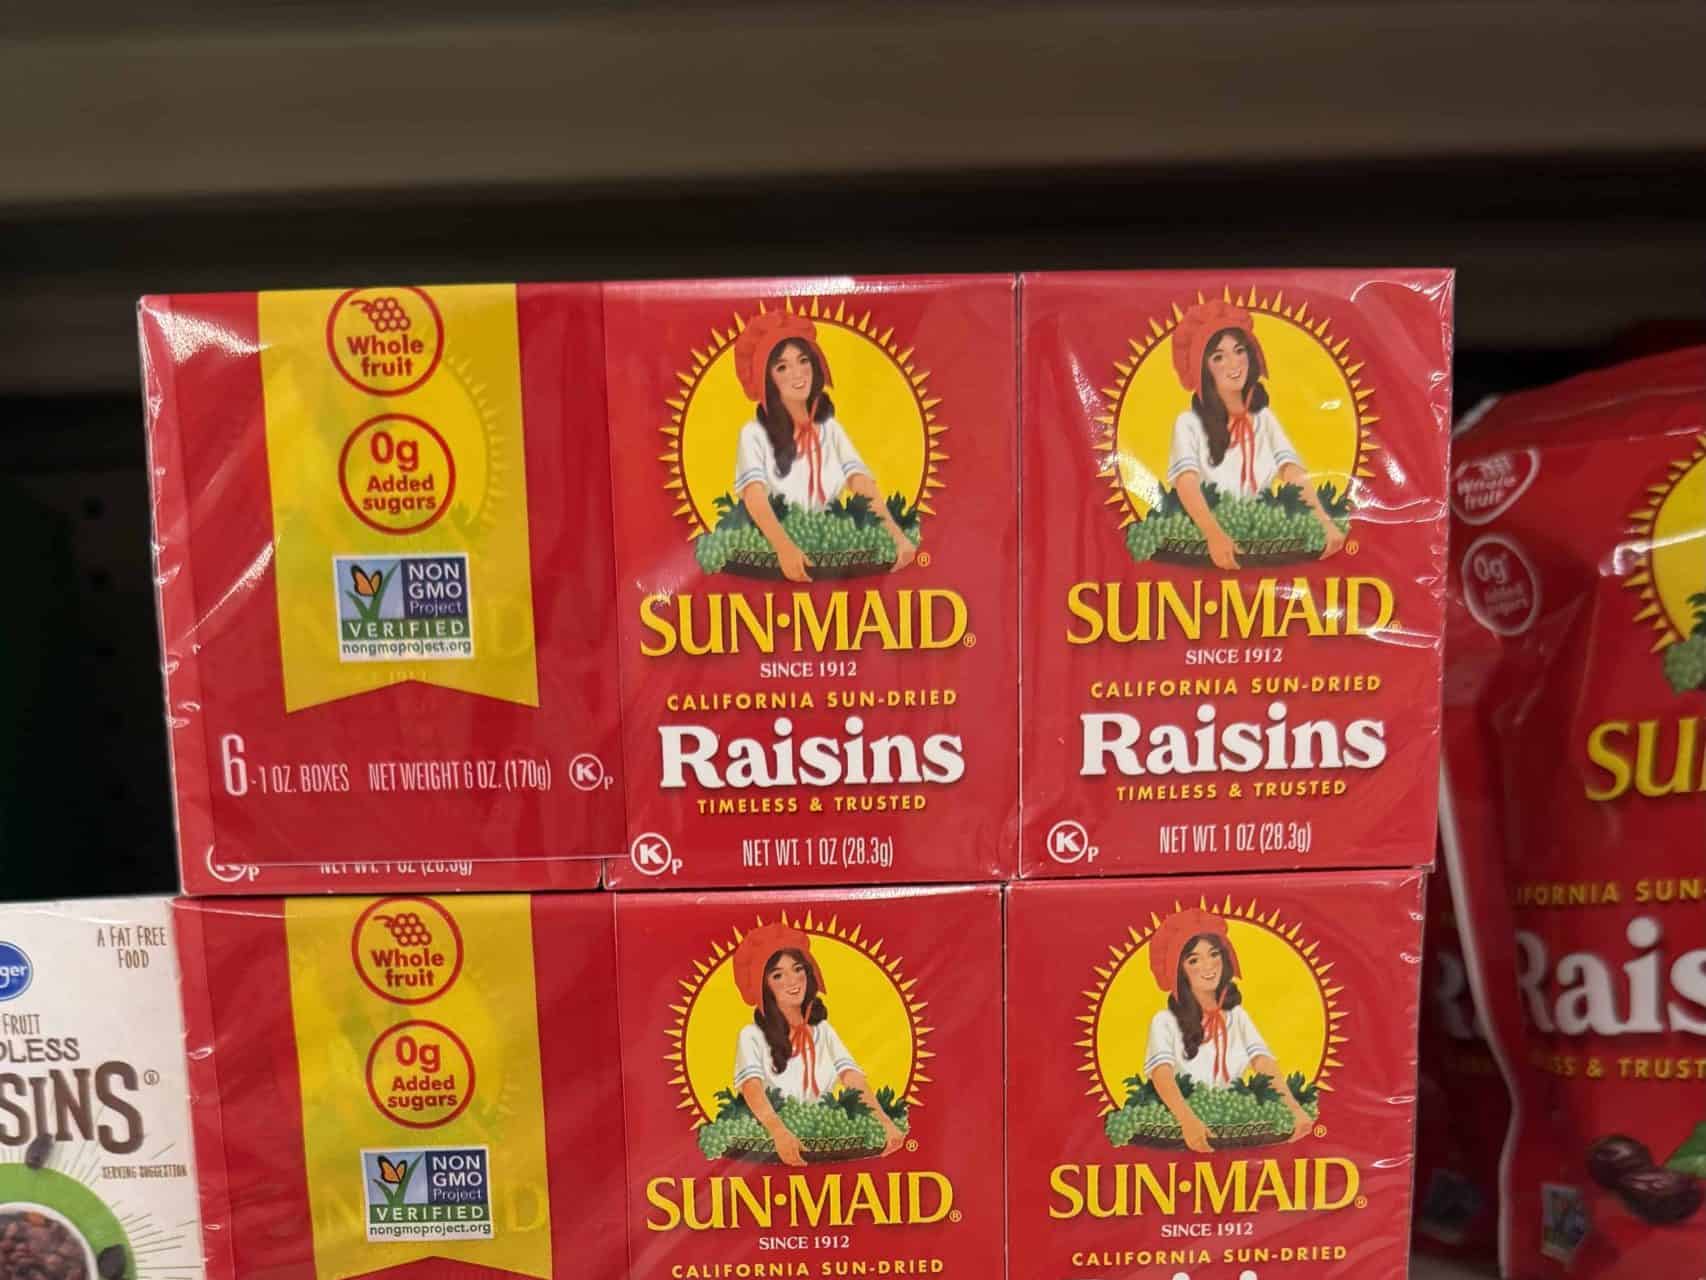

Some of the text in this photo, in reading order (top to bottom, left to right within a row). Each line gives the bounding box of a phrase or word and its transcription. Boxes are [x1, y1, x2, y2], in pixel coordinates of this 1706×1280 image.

[347, 334, 424, 356] Whole
[361, 356, 413, 377] fruit
[371, 431, 419, 472] 0g
[367, 474, 434, 492] Added
[362, 494, 437, 515] sugars
[409, 563, 460, 581] NON
[409, 581, 462, 600] GMO
[410, 600, 463, 617] Project
[349, 620, 465, 637] VERIFIED
[342, 639, 472, 657] nongmoproject.org
[1185, 648, 1283, 665] SINCE 1912
[760, 661, 857, 678] SINCE 1912
[1091, 675, 1382, 698] CALIFORNIA SUN-DRIED
[667, 690, 957, 711] CALIFORNIA SUN-DRIED
[1080, 702, 1387, 776] Raisins
[657, 715, 966, 788] Raisins
[1585, 717, 1706, 802] SU
[300, 761, 461, 793] BOXES NET WEIGHT
[1117, 780, 1347, 801] TIMELESS TRUSTED
[697, 795, 927, 815] TIMELESS TRUSTED
[1160, 821, 1312, 854] NET (28.3g)
[743, 836, 893, 868] NET (28.3g)
[110, 925, 167, 947] FAT FREE
[118, 950, 149, 969] FOOD
[370, 949, 444, 968] Whole
[385, 969, 434, 987] fruit
[2, 1014, 40, 1036] FRUIT
[395, 1035, 441, 1073] 0g
[392, 1075, 455, 1092] Added
[387, 1093, 457, 1112] sugars
[433, 1155, 480, 1171] NON
[433, 1171, 482, 1187] GMO
[433, 1188, 482, 1203] Project
[376, 1206, 483, 1221] VERIFIED
[370, 1222, 491, 1237] nongmoproject.org
[1161, 1222, 1253, 1238] SINCE 1912
[759, 1235, 850, 1250] SINCE 1912
[1072, 1246, 1347, 1267] CALIFORNIA SUN-DRIED
[672, 1259, 944, 1279] CALIFORNIA SUN-DRIED
